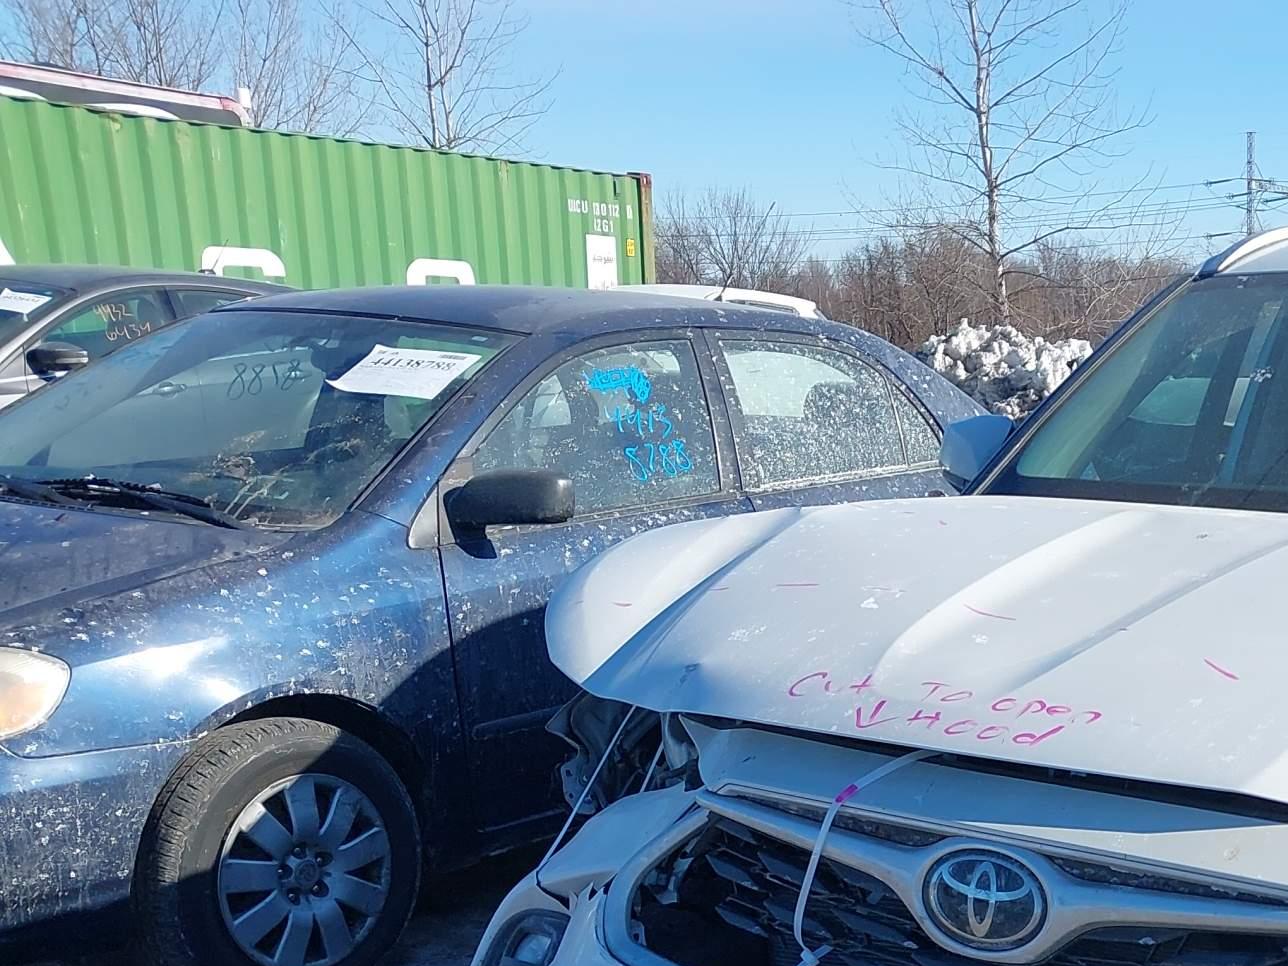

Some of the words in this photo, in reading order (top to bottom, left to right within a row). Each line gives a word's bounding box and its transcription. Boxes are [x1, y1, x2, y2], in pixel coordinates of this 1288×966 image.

[105, 321, 151, 341] 6434
[603, 403, 673, 440] 4413
[623, 438, 692, 482] 8788
